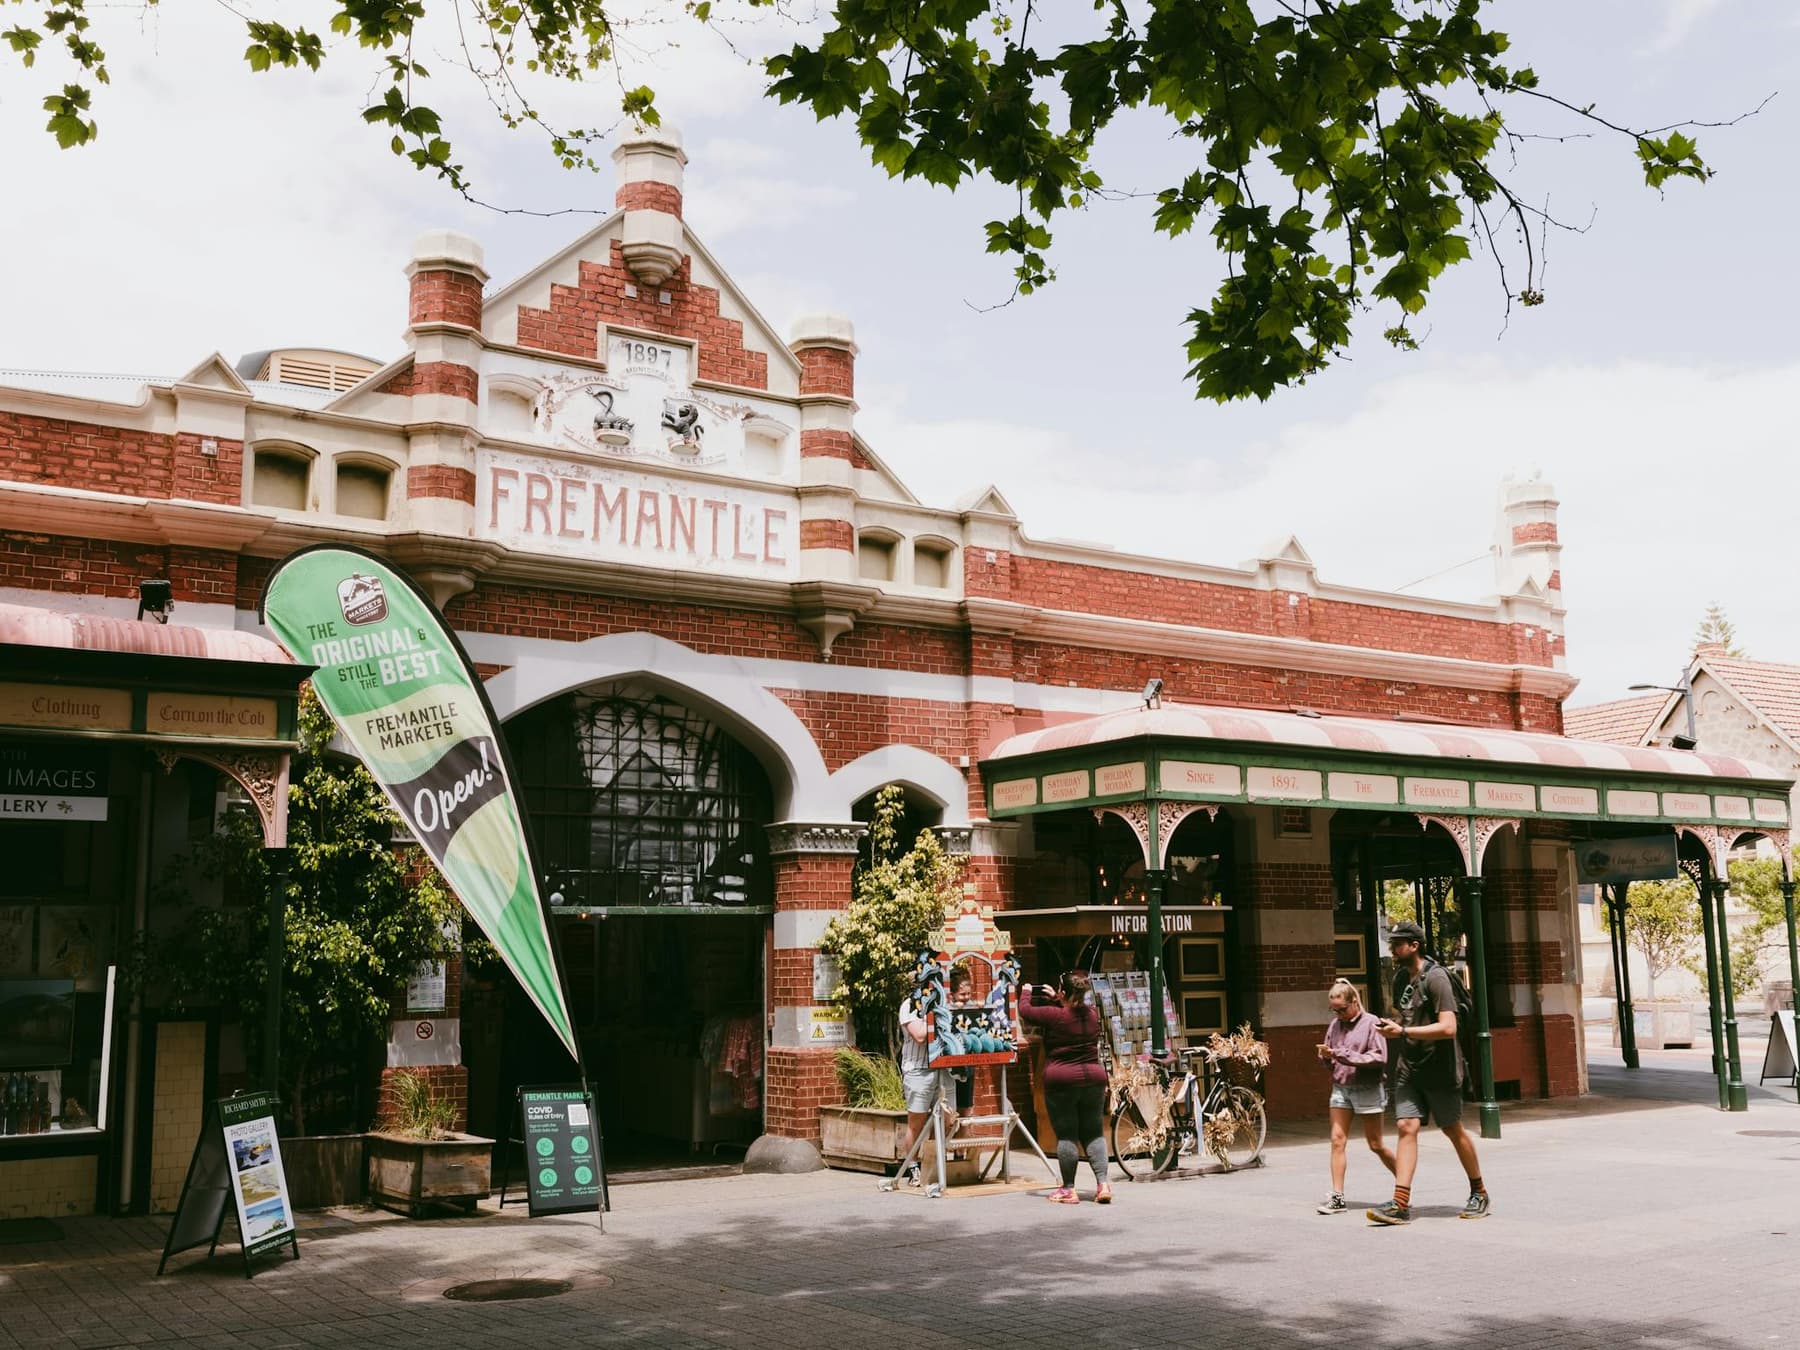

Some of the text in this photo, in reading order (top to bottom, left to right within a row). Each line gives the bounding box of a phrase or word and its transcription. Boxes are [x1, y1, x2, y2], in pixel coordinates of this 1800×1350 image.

[625, 342, 672, 368] 1897
[489, 466, 787, 566] FREMANTLE
[348, 598, 383, 618] MARKETS
[307, 621, 338, 642] THE
[311, 628, 427, 667] ORIGINAL &
[337, 662, 377, 683] STILL
[379, 649, 441, 686] BEST
[359, 676, 379, 690] THE
[31, 696, 101, 719] Clothing
[160, 704, 265, 726] Corn on the Cob
[366, 702, 459, 736] FREMANTLE
[379, 721, 454, 750] MARKETS
[8, 767, 97, 789] IMAGES
[413, 741, 494, 833] Open!
[1047, 774, 1082, 790] SATURDAY
[1103, 779, 1133, 793] MONDAY
[1186, 770, 1215, 784] SINCE
[1354, 781, 1374, 793] THE
[1413, 784, 1460, 799] FREMANTLE
[1487, 788, 1524, 802] MARKETS
[0, 799, 48, 813] LERY
[1111, 913, 1193, 934] INFORATION
[525, 1092, 562, 1101] FREMANTLE
[223, 1101, 249, 1115] RICHARD
[527, 1106, 553, 1114] COVID
[230, 1126, 248, 1138] PHOTO
